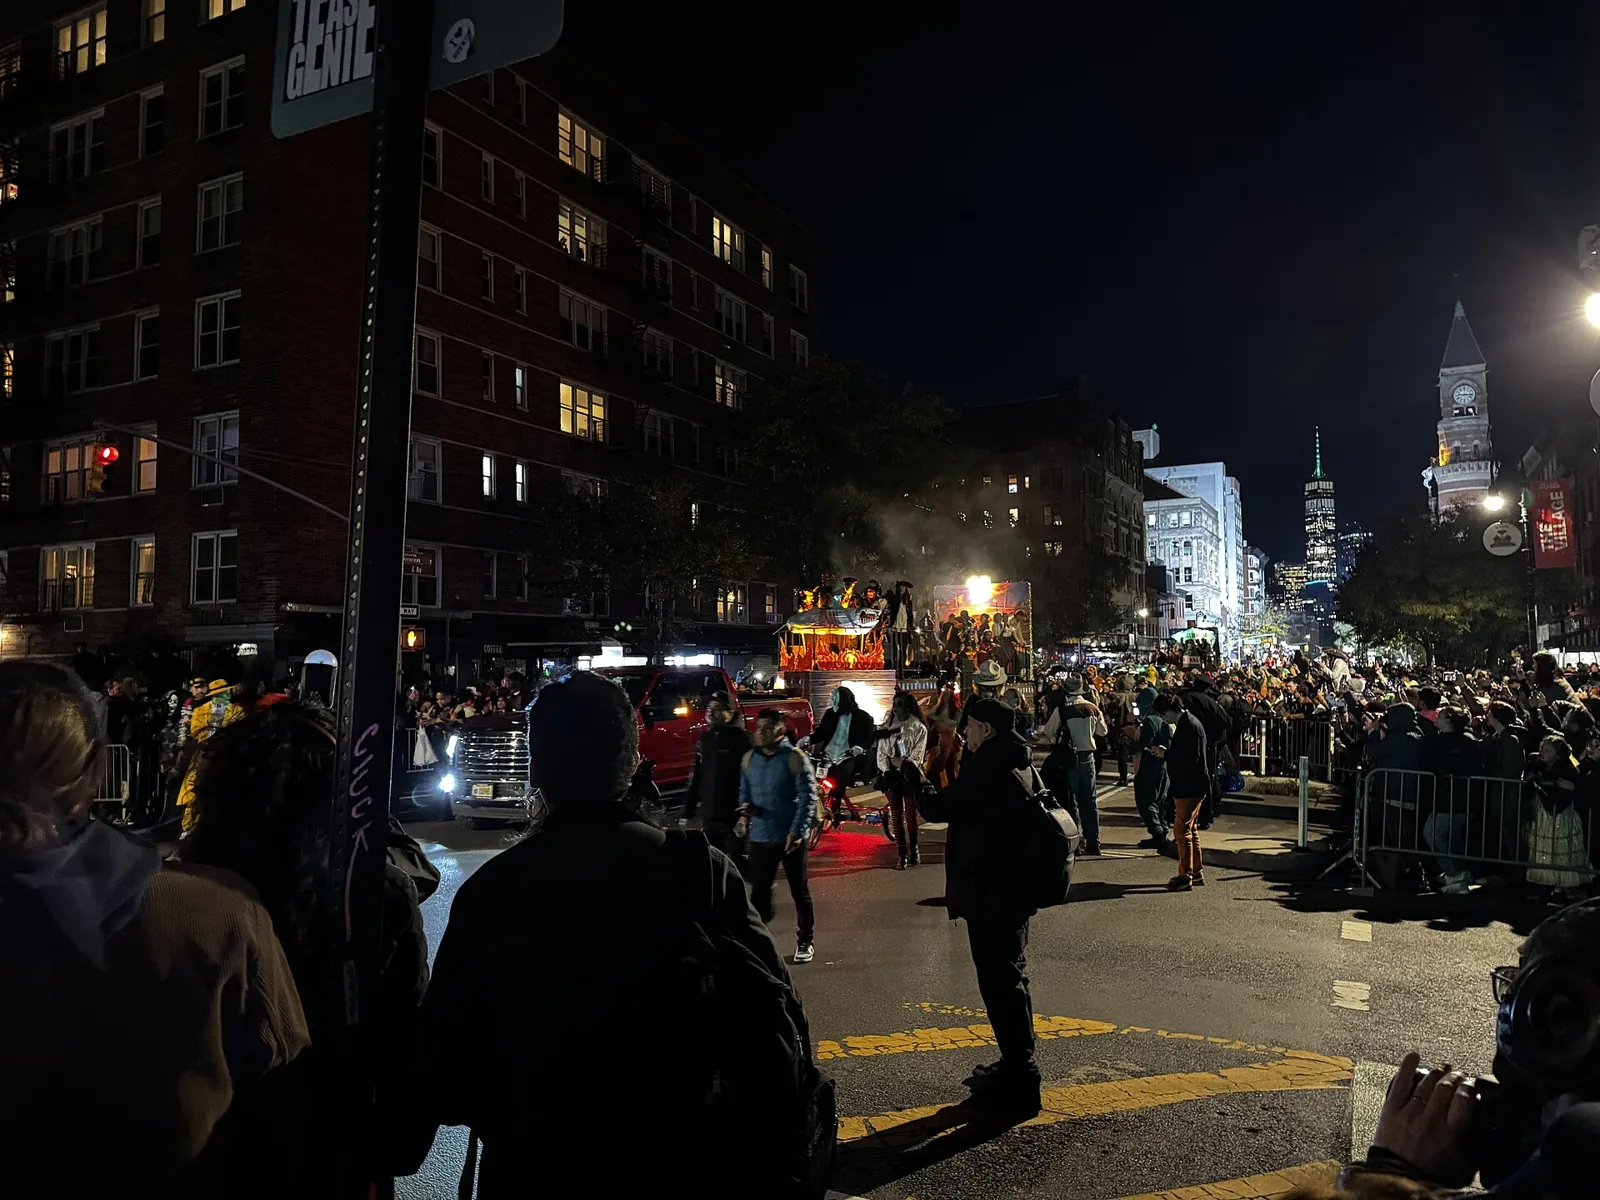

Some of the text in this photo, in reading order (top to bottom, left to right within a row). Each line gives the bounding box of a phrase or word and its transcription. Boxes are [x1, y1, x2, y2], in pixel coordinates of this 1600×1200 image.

[286, 24, 375, 100] GENIE
[1550, 491, 1568, 551] VILLAGE
[483, 644, 503, 654] COFFEE
